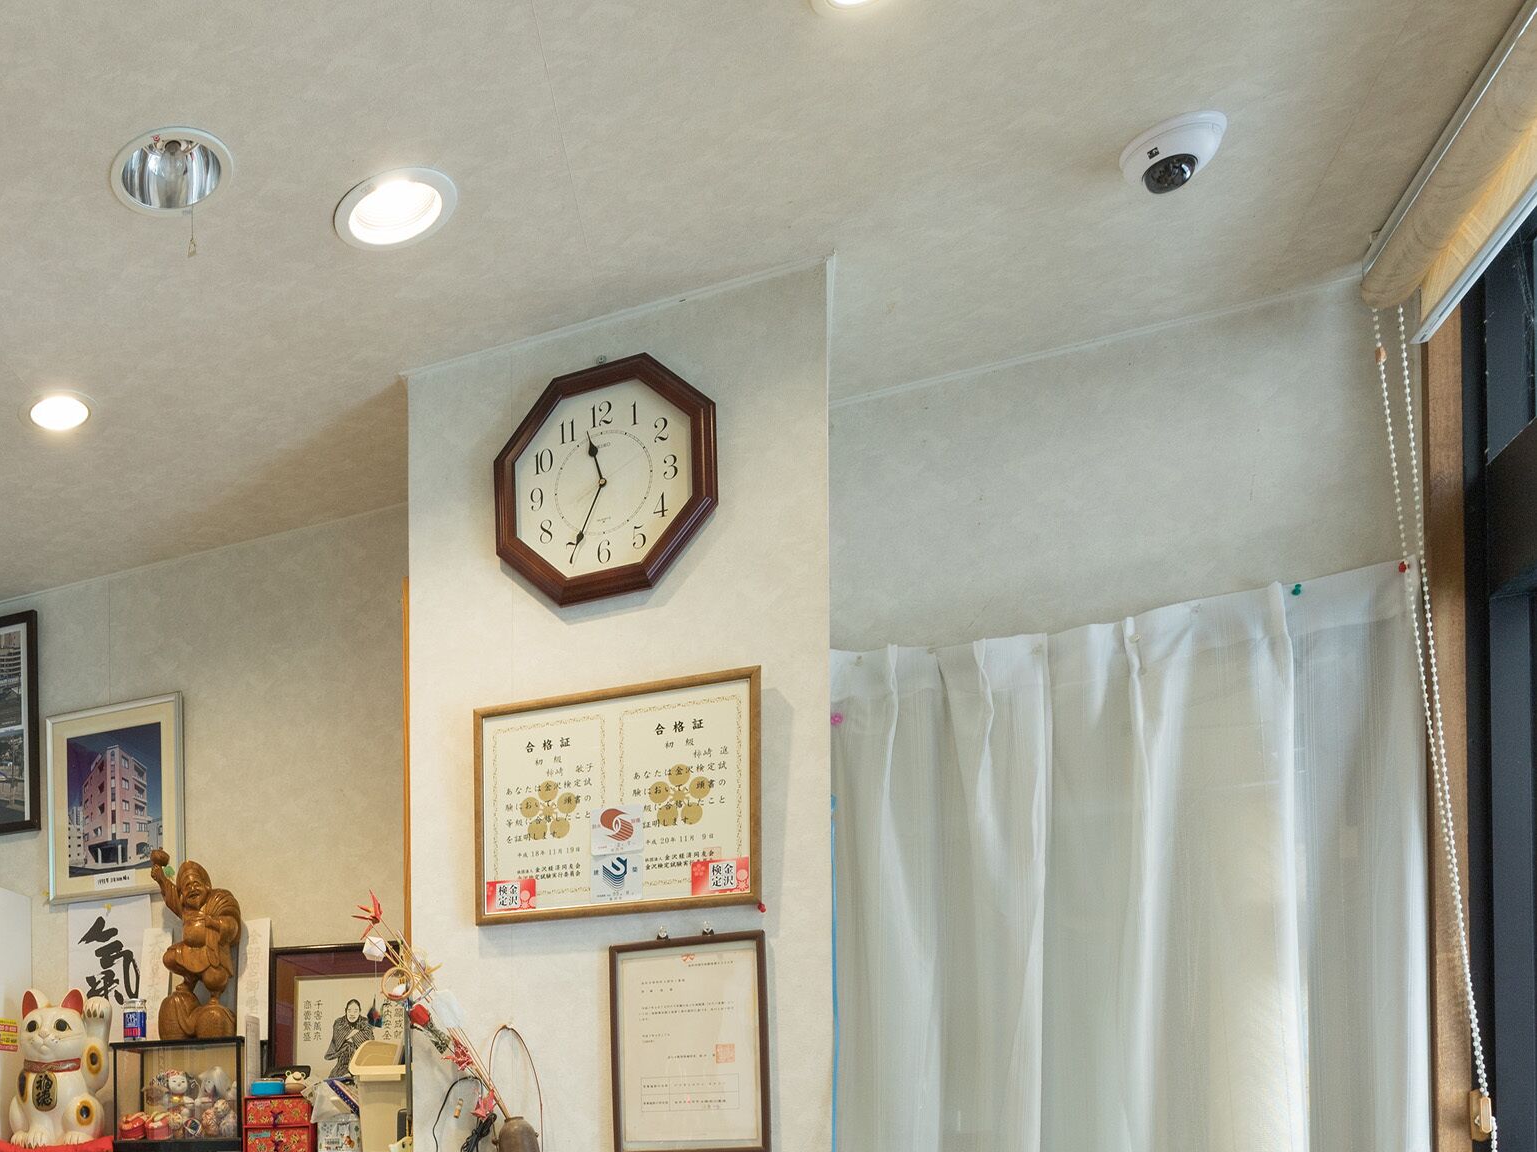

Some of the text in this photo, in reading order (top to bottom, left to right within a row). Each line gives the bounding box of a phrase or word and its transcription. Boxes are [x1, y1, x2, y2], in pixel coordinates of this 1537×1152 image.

[590, 401, 613, 429] 12
[631, 401, 639, 426] 1
[559, 418, 575, 445] 11
[654, 417, 668, 443] 2
[534, 448, 553, 475] 10
[663, 454, 678, 480] 3
[530, 488, 543, 511] 9
[653, 492, 668, 518] 4
[540, 519, 552, 544] 8
[632, 525, 646, 550] 5
[566, 541, 578, 564] 7
[597, 540, 611, 564] 6
[655, 718, 704, 736] 合格証
[525, 737, 571, 753] 合格証
[633, 761, 727, 780] あなたは金沢検定試
[505, 777, 593, 796] あなたは金沢検定試
[712, 864, 722, 887] 検定
[723, 863, 734, 886] 金沢
[497, 884, 508, 907] 検定
[508, 885, 519, 907] 金沢
